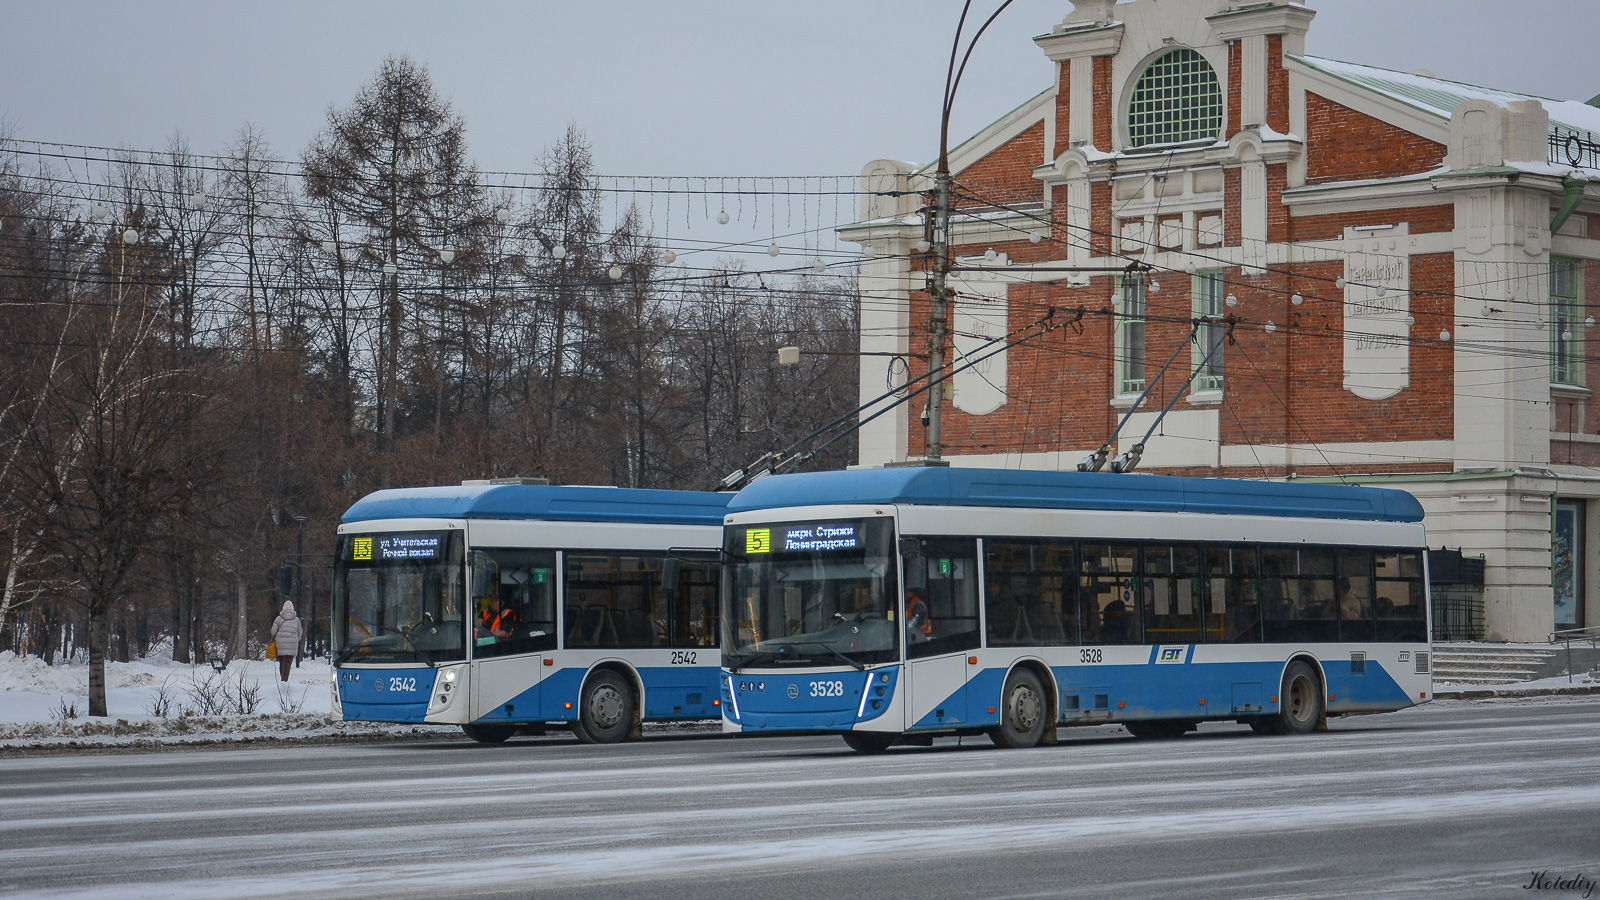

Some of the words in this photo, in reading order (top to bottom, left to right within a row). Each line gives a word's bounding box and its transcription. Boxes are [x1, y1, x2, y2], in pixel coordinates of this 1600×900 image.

[816, 526, 854, 538] Стрижи
[752, 532, 763, 550] 5
[785, 538, 857, 551] Ленинградская
[671, 651, 697, 665] 2542
[1080, 648, 1103, 663] 3528
[389, 677, 417, 692] 2542
[809, 681, 844, 697] 3528
